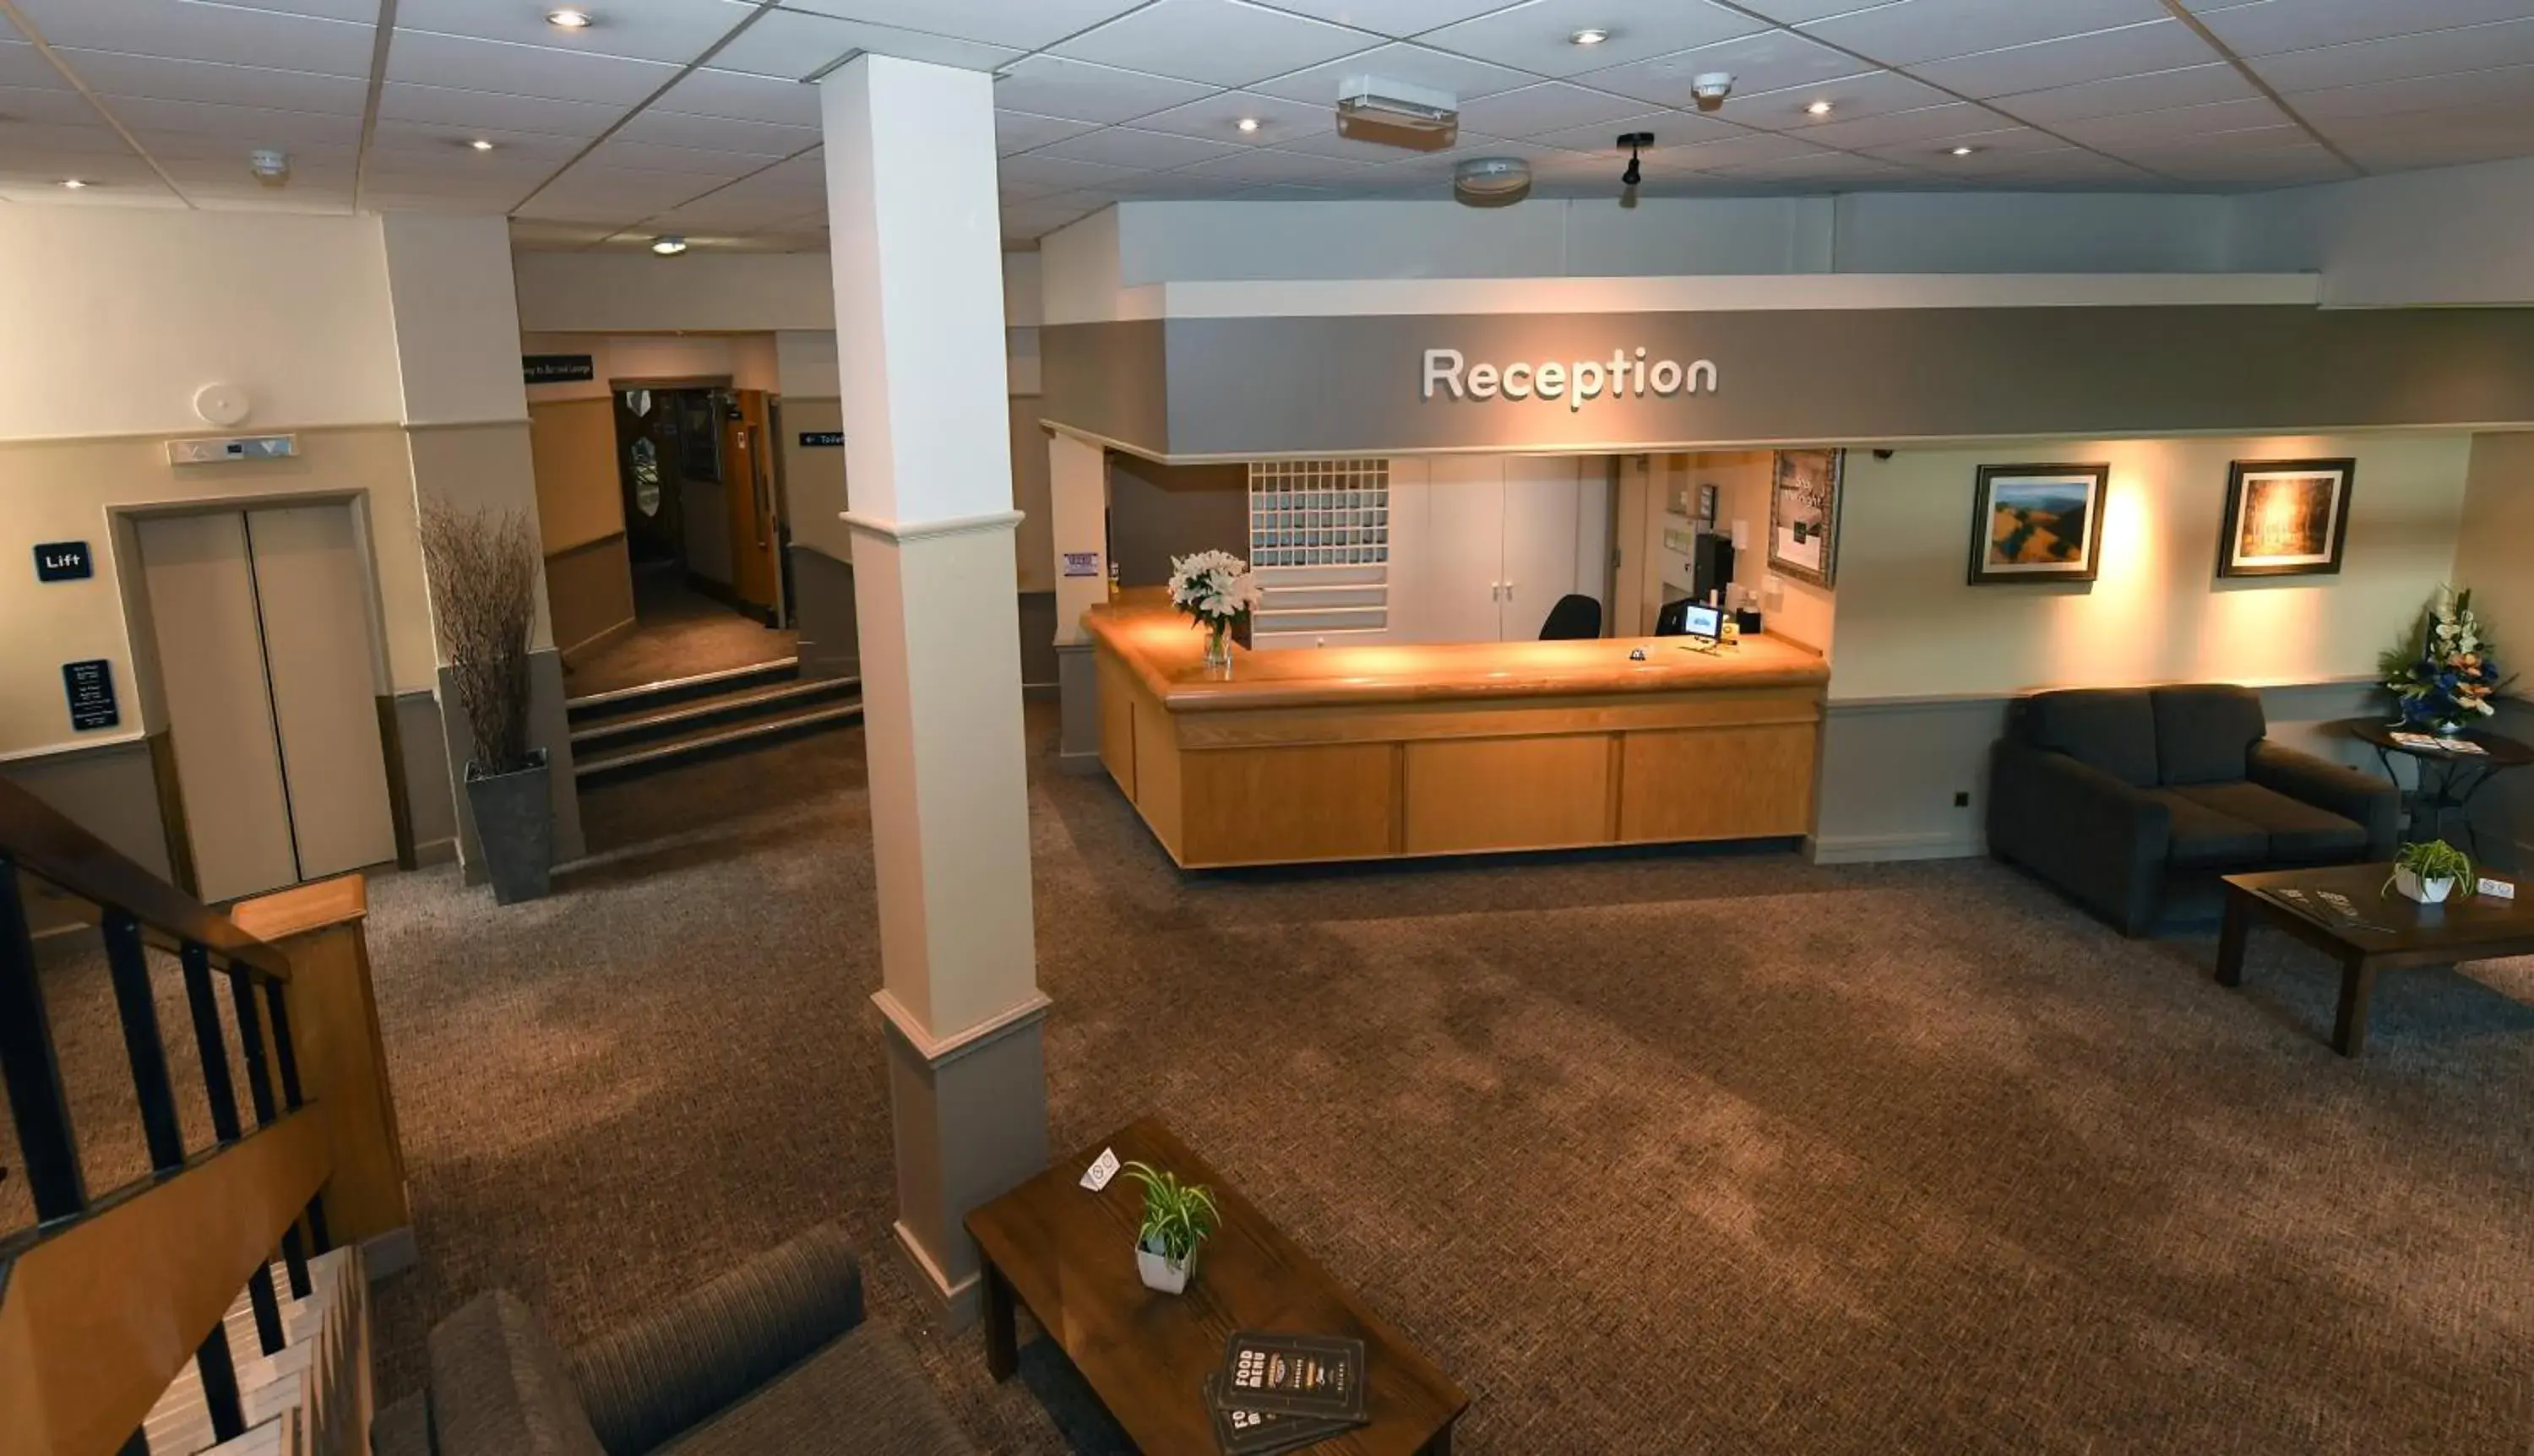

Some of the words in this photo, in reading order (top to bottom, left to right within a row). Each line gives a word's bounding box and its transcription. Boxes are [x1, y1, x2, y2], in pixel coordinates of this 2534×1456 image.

[1422, 346, 1718, 410] Reception
[46, 554, 80, 568] Lift
[1235, 1350, 1253, 1387] FOOD
[1249, 1351, 1266, 1388] MENU
[1232, 1410, 1248, 1429] FO
